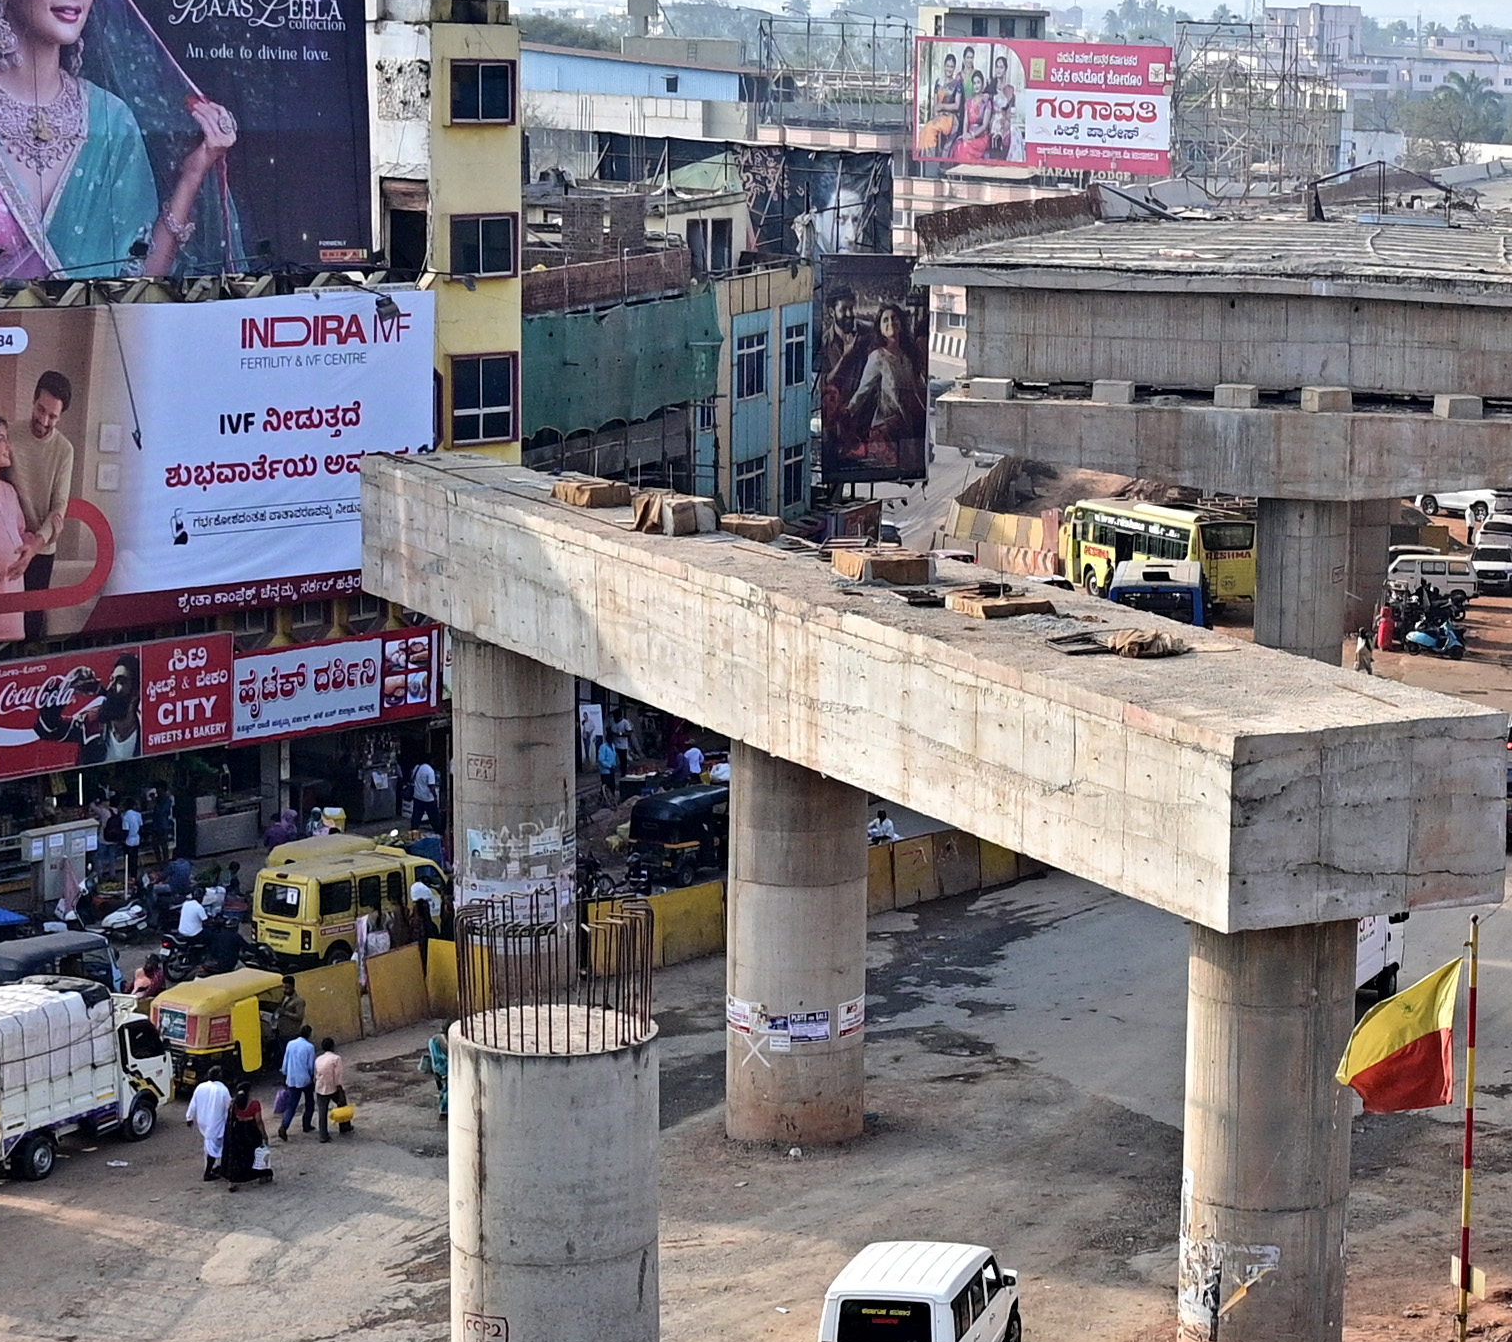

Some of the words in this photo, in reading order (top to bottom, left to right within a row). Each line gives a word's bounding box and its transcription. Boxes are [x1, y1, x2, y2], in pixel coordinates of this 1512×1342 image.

[289, 18, 346, 31] collection
[211, 44, 234, 59] ode
[240, 45, 252, 59] to
[258, 45, 298, 60] divine
[1036, 95, 1157, 123] ಗಂಗಾವತಿ
[1054, 123, 1079, 140] ಸಿಲ್ಕ್
[241, 313, 367, 349] INDIRA
[373, 312, 413, 344] IVF
[240, 356, 292, 370] FERTILITY
[295, 357, 303, 367] &
[305, 355, 322, 367] IVF
[324, 352, 367, 366] CENTRE
[220, 411, 256, 435] IVF
[262, 401, 362, 438] ನೀಡುತ್ತದೆ
[165, 454, 318, 492] ಶುಭವಾರ್ತೆಯ
[1206, 551, 1251, 559] RESHMA
[300, 578, 335, 596] ಸರ್ಕಲ್
[168, 646, 208, 671] ಸಿಟಿ
[180, 677, 190, 692] &
[195, 668, 229, 689] ಬೇಕರಿ
[237, 662, 309, 722] ಹೈಟೆಕ್
[313, 656, 377, 694] ದರ್ಶಿನಿ
[156, 693, 219, 726] CITY
[147, 727, 182, 746] SWEETS
[183, 728, 192, 742] &
[193, 722, 227, 739] BAKERY
